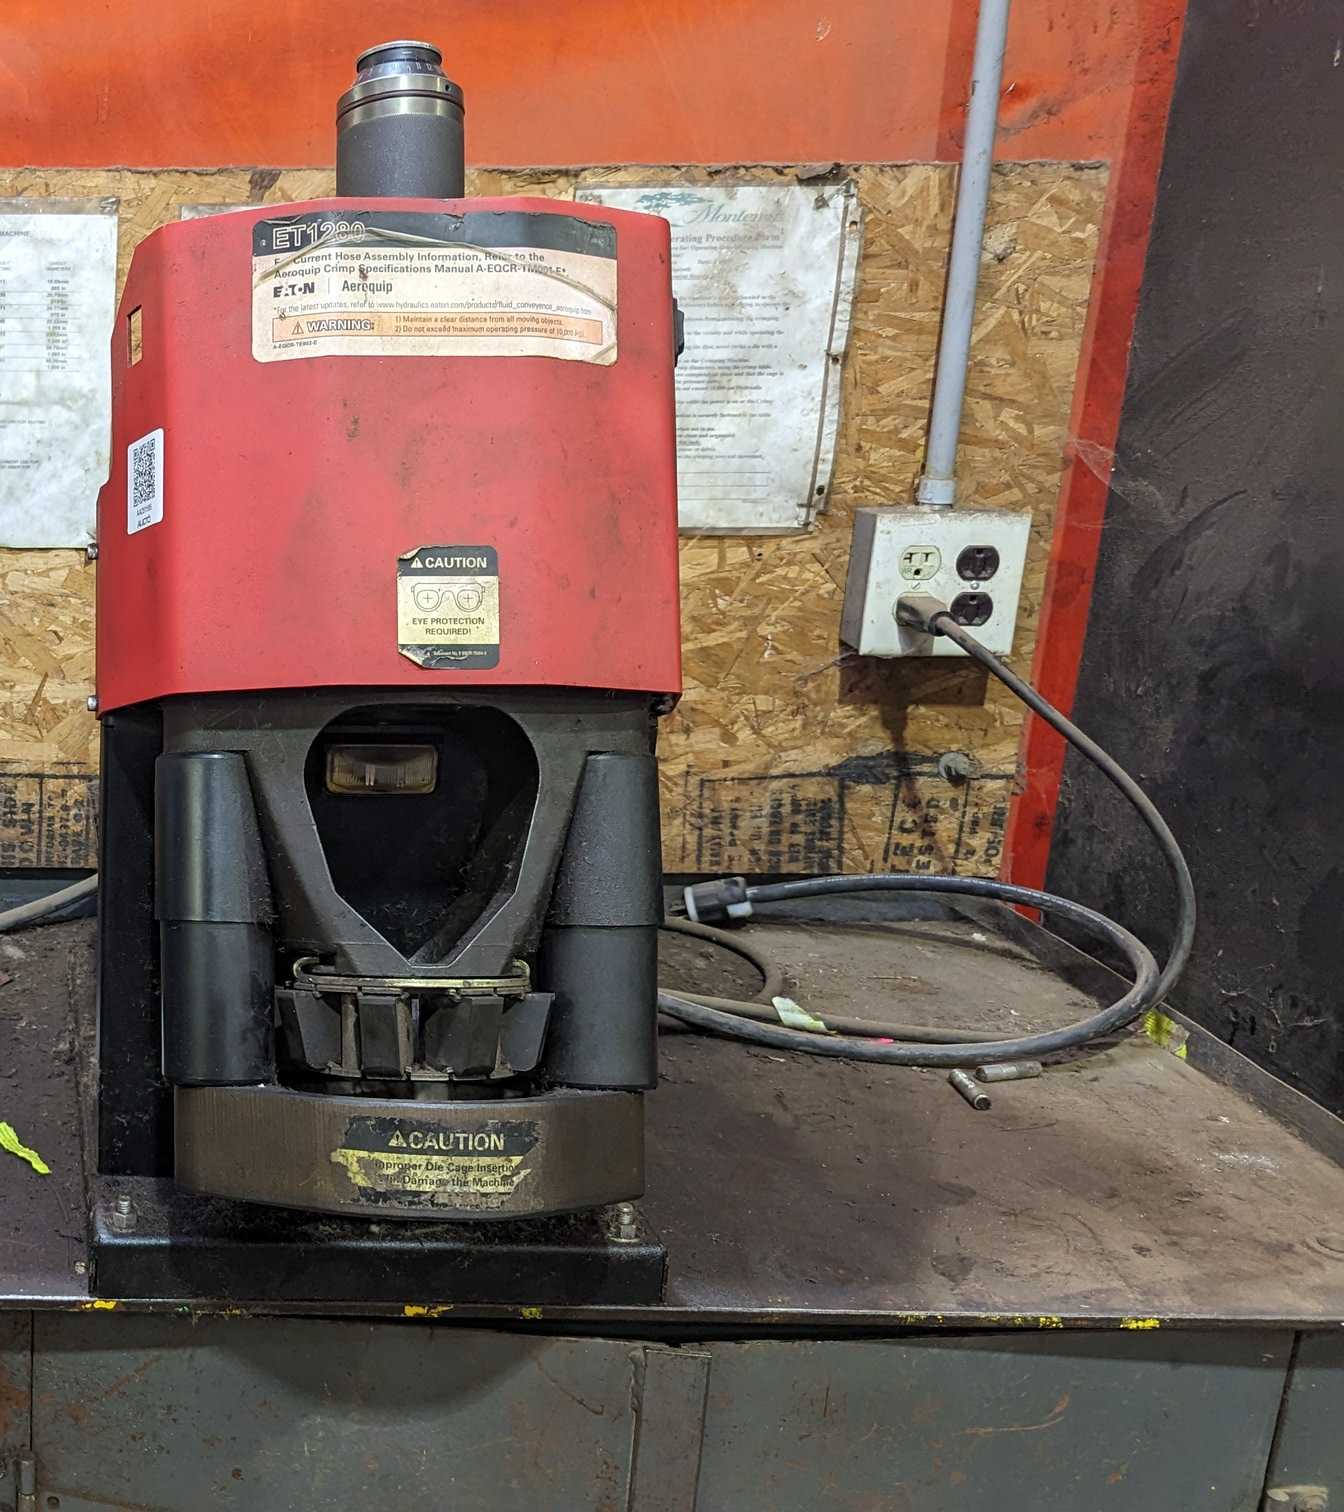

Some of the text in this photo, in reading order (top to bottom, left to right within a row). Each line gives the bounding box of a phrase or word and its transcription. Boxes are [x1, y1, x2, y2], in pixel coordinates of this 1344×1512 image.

[272, 220, 366, 251] ET1280
[293, 252, 332, 266] Current
[335, 251, 362, 261] Hose
[364, 251, 415, 263] Assembly
[417, 252, 482, 263] Information,
[514, 253, 526, 262] to
[528, 252, 545, 262] the
[273, 266, 321, 279] Aeroquip
[323, 263, 356, 275] Crimp
[358, 262, 432, 274] Specifications
[434, 263, 474, 274] Manual
[342, 279, 394, 295] Aeroquip
[288, 304, 300, 313] the
[301, 303, 320, 312] latest
[350, 301, 367, 309] refer
[367, 301, 376, 309] to
[306, 318, 376, 334] WARNING:
[395, 315, 402, 324] 1)
[403, 315, 433, 323] Maintain
[440, 315, 458, 323] clear
[459, 315, 489, 324] distance
[489, 315, 505, 324] from
[506, 315, 515, 323] all
[516, 315, 540, 325] moving
[395, 325, 403, 334] 2)
[403, 325, 413, 333] Do
[413, 325, 425, 334] not
[426, 325, 451, 333] exceed
[485, 325, 518, 335] operating
[519, 325, 549, 335] pressure
[424, 556, 488, 569] CAUTION
[411, 616, 486, 626] EYE PROTECTION
[424, 627, 472, 636] REQUIRED!
[407, 1131, 505, 1151] CAUTION
[425, 1161, 445, 1173] Die
[446, 1162, 474, 1175] Cage
[451, 1175, 470, 1187] the
